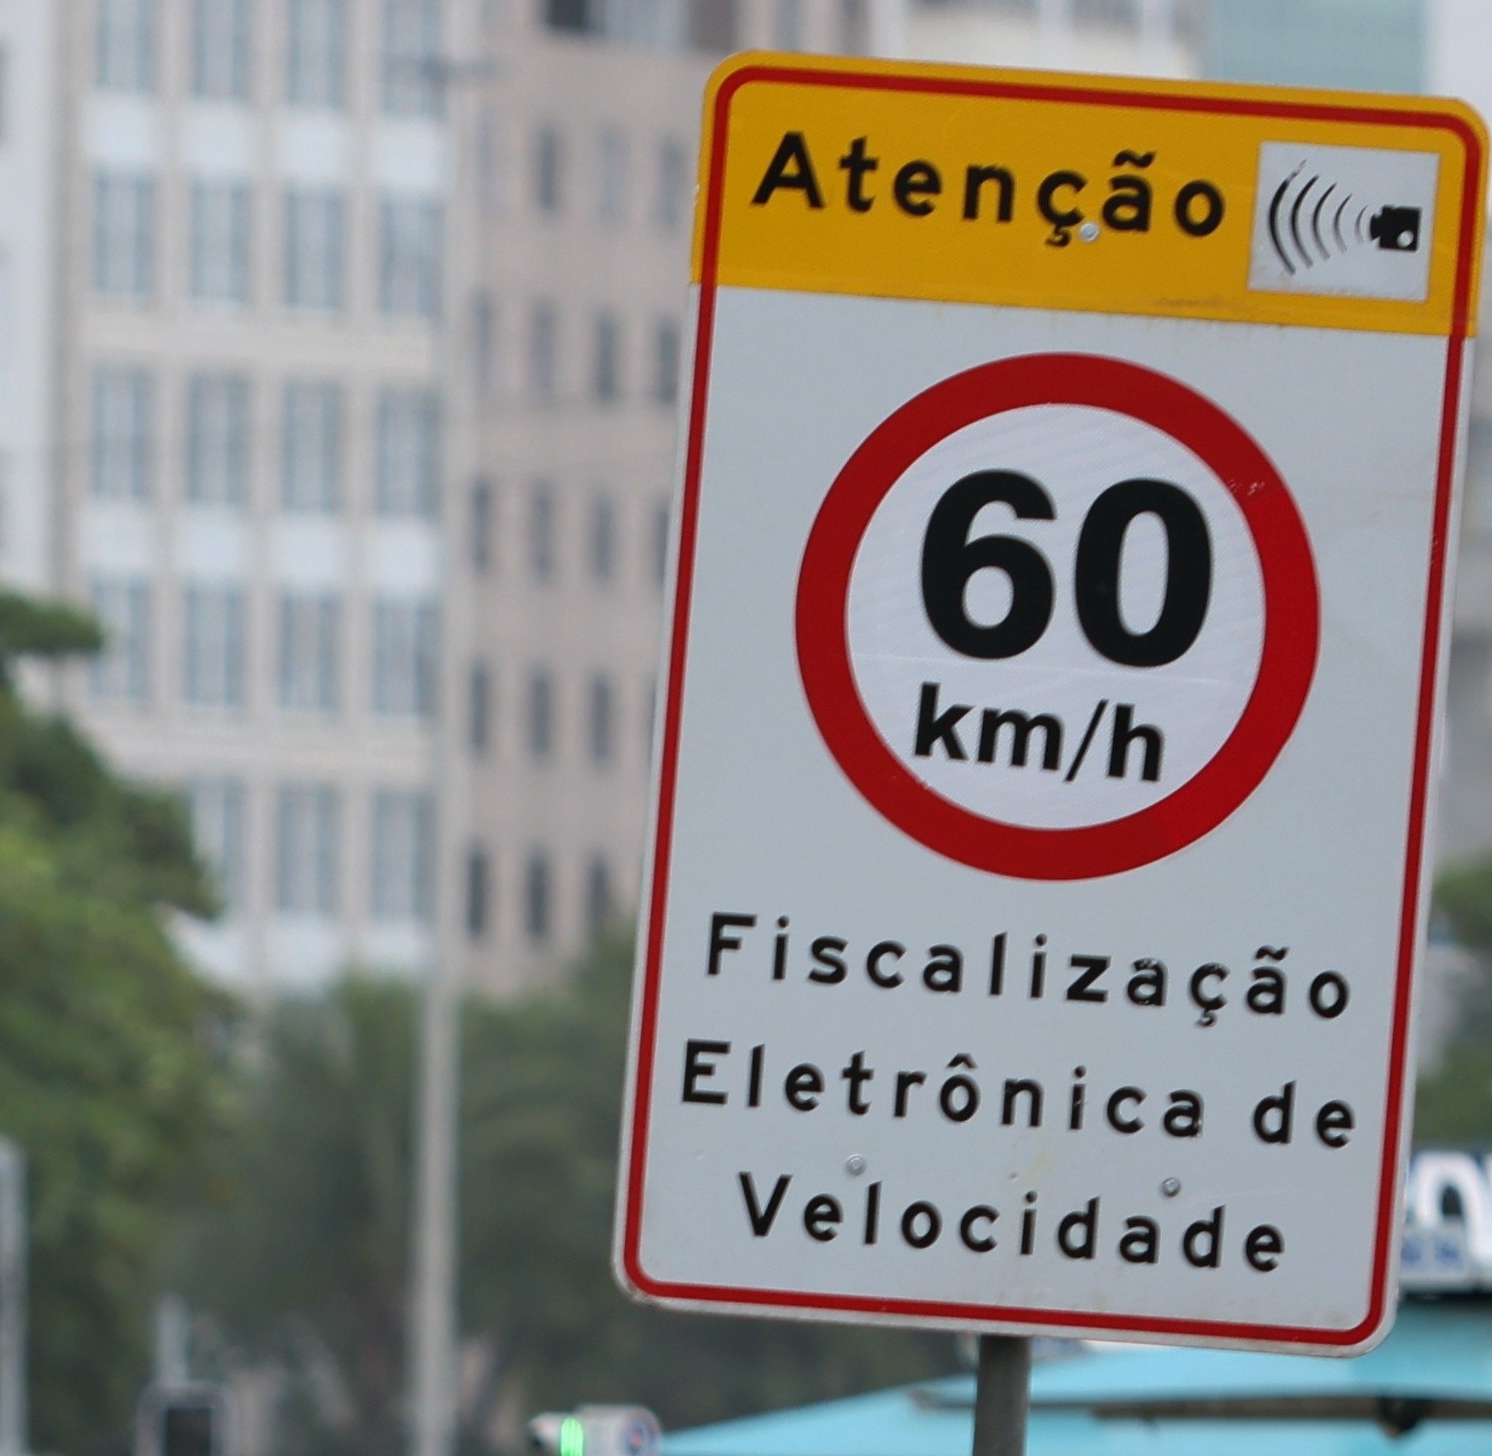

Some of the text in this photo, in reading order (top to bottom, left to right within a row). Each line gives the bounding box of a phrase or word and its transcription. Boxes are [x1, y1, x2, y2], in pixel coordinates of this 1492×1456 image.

[752, 130, 1225, 248] Atenção
[920, 469, 1214, 668] 60
[914, 681, 1166, 783] km/h
[705, 911, 1351, 1027] Fiscalização
[680, 1039, 1356, 1149] Eletrônica de
[739, 1172, 1285, 1272] Velocidade
